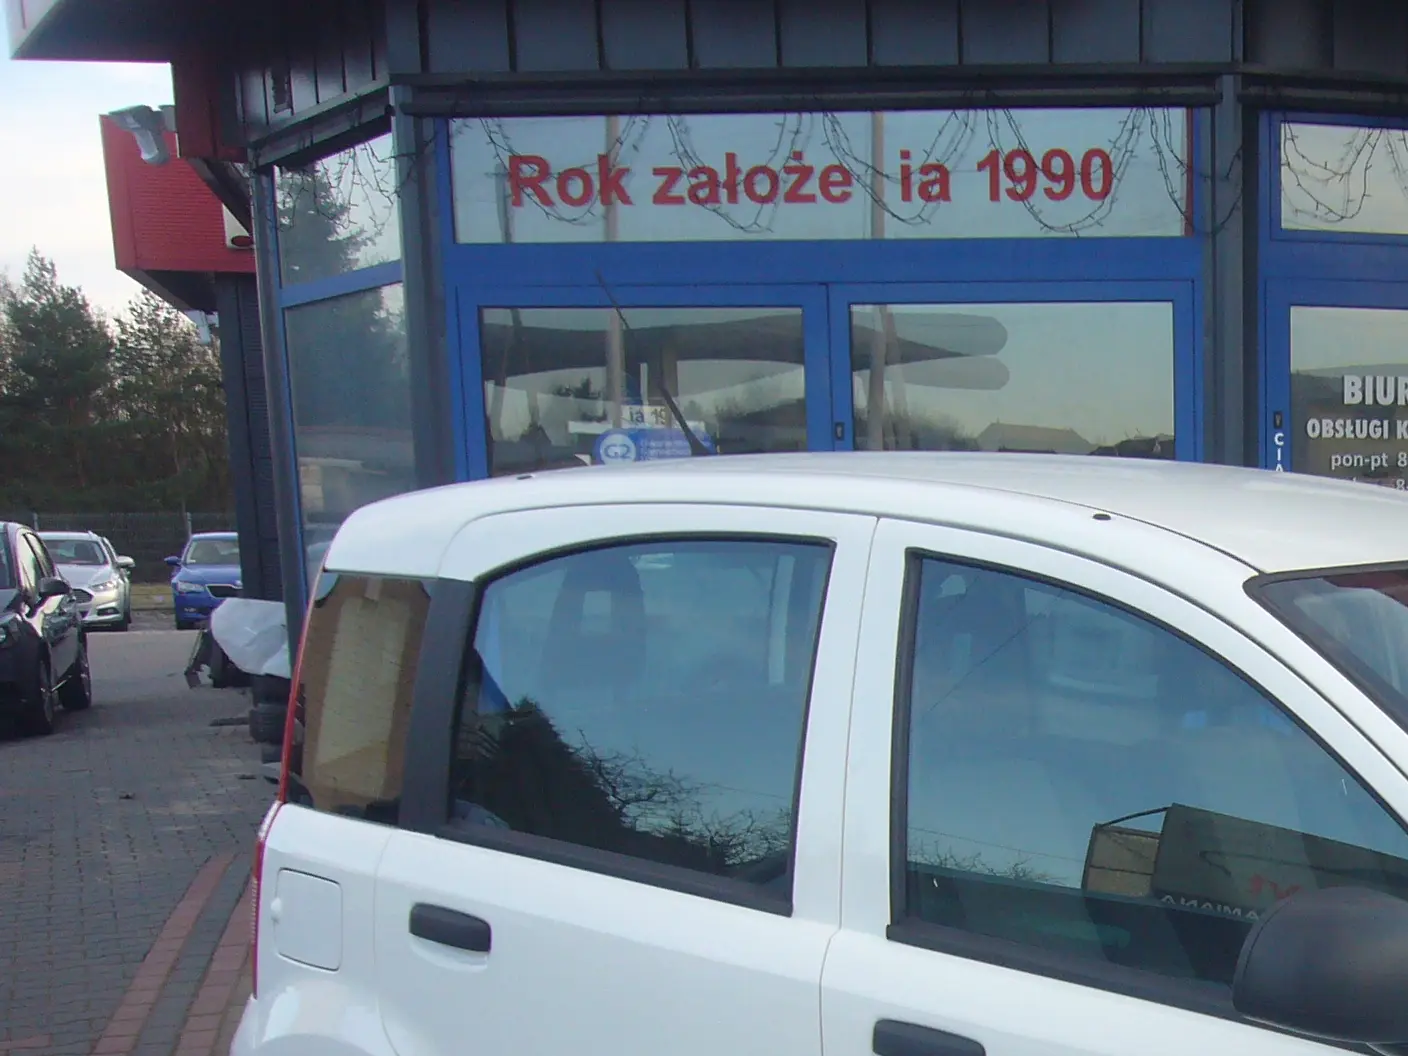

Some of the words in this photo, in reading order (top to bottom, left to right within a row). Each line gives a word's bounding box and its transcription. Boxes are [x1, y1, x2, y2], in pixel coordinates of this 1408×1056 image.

[508, 152, 634, 207] Rok
[976, 147, 1114, 203] 1990
[1306, 418, 1389, 440] OBSŁUGI
[1331, 452, 1389, 470] pon-pt
